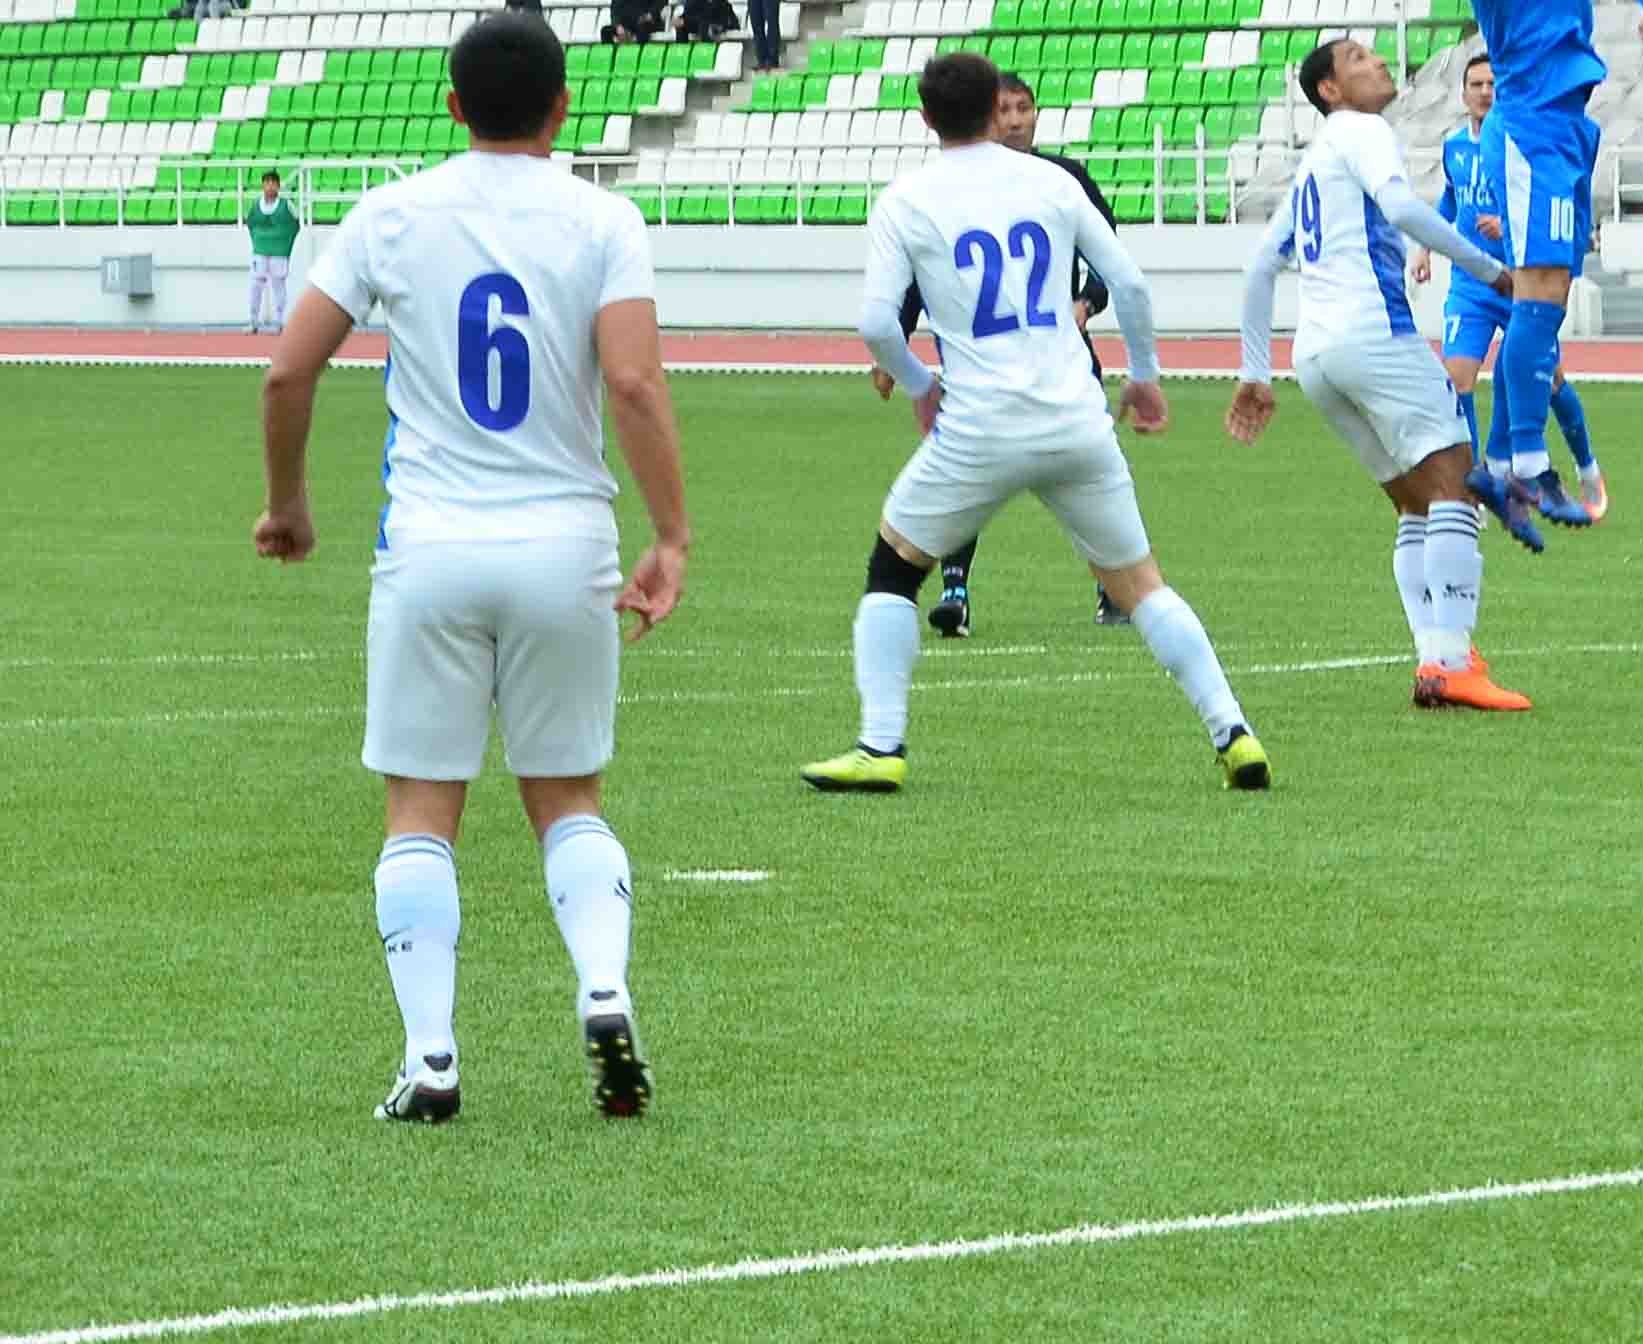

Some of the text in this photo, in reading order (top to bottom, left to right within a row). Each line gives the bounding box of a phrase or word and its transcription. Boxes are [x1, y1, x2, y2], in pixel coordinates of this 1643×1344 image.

[1550, 196, 1575, 242] 10
[954, 220, 1058, 339] 22
[457, 272, 532, 433] 6
